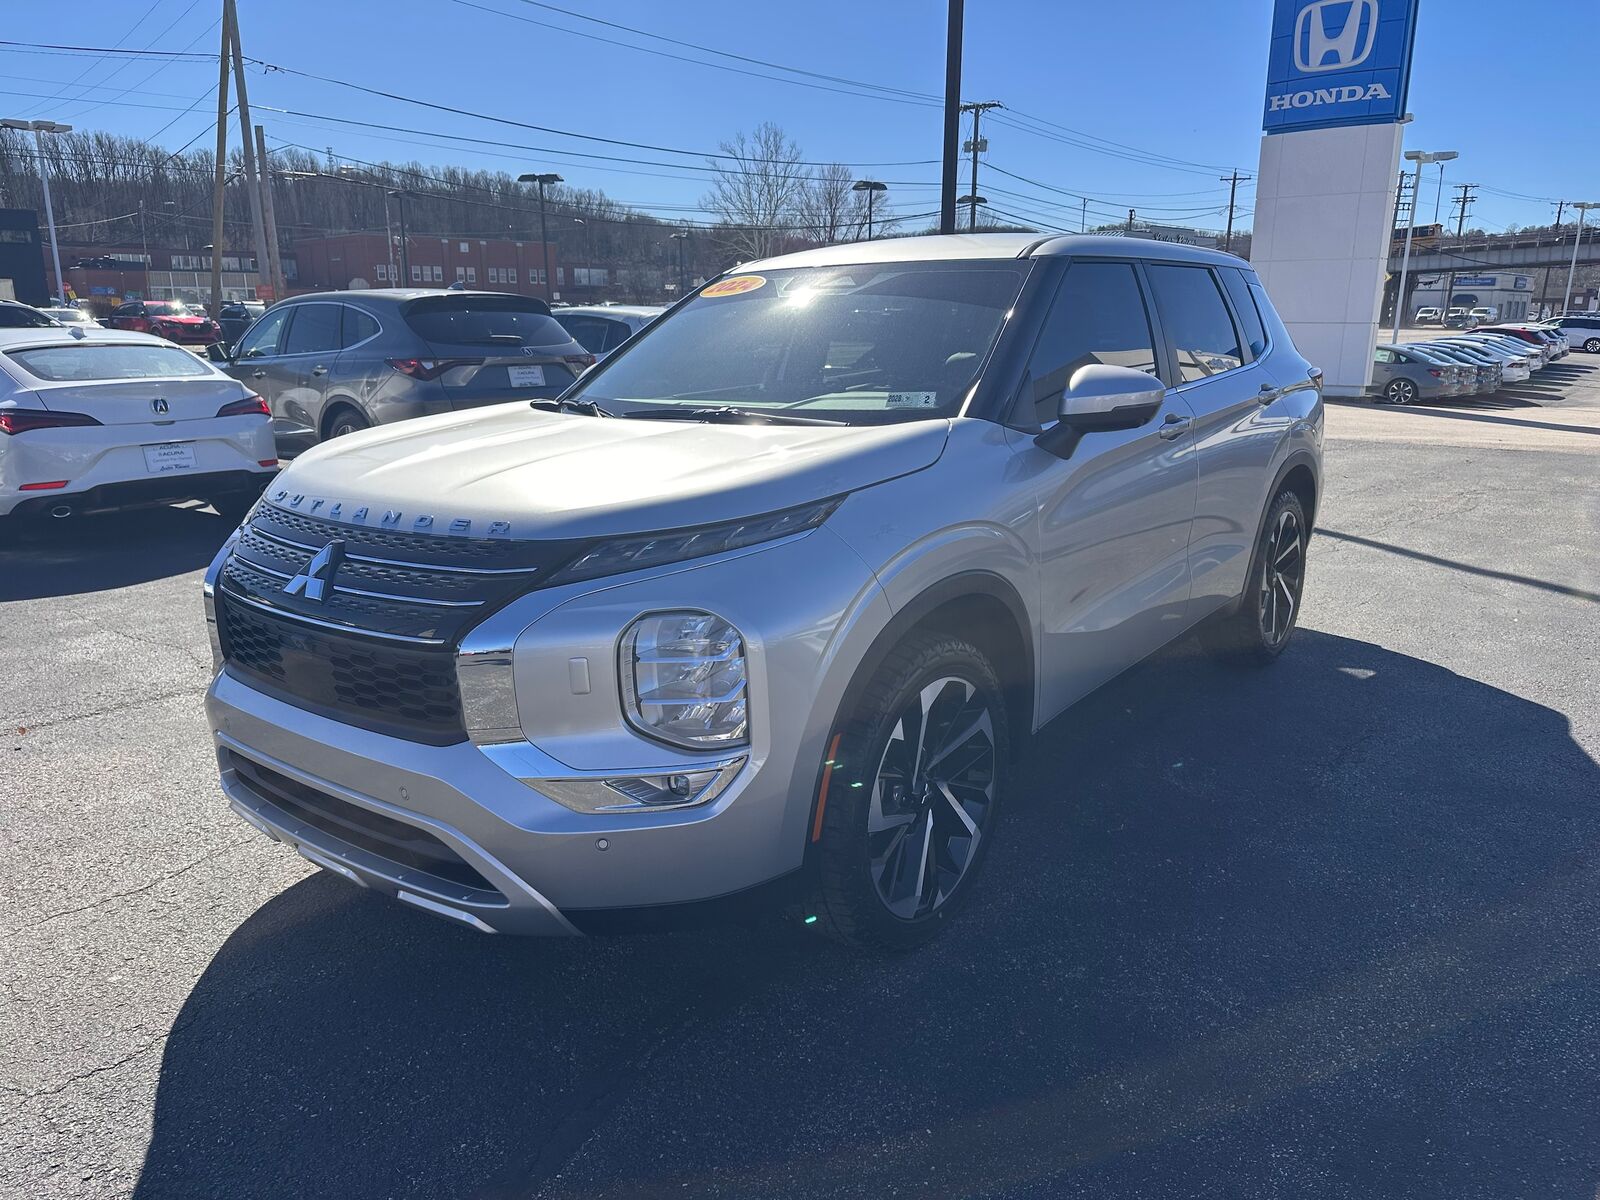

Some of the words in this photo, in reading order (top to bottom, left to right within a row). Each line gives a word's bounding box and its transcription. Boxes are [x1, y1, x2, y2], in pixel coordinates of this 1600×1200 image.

[1268, 83, 1391, 111] HONDA
[924, 395, 930, 403] 2
[275, 490, 511, 534] OUTLANDER
